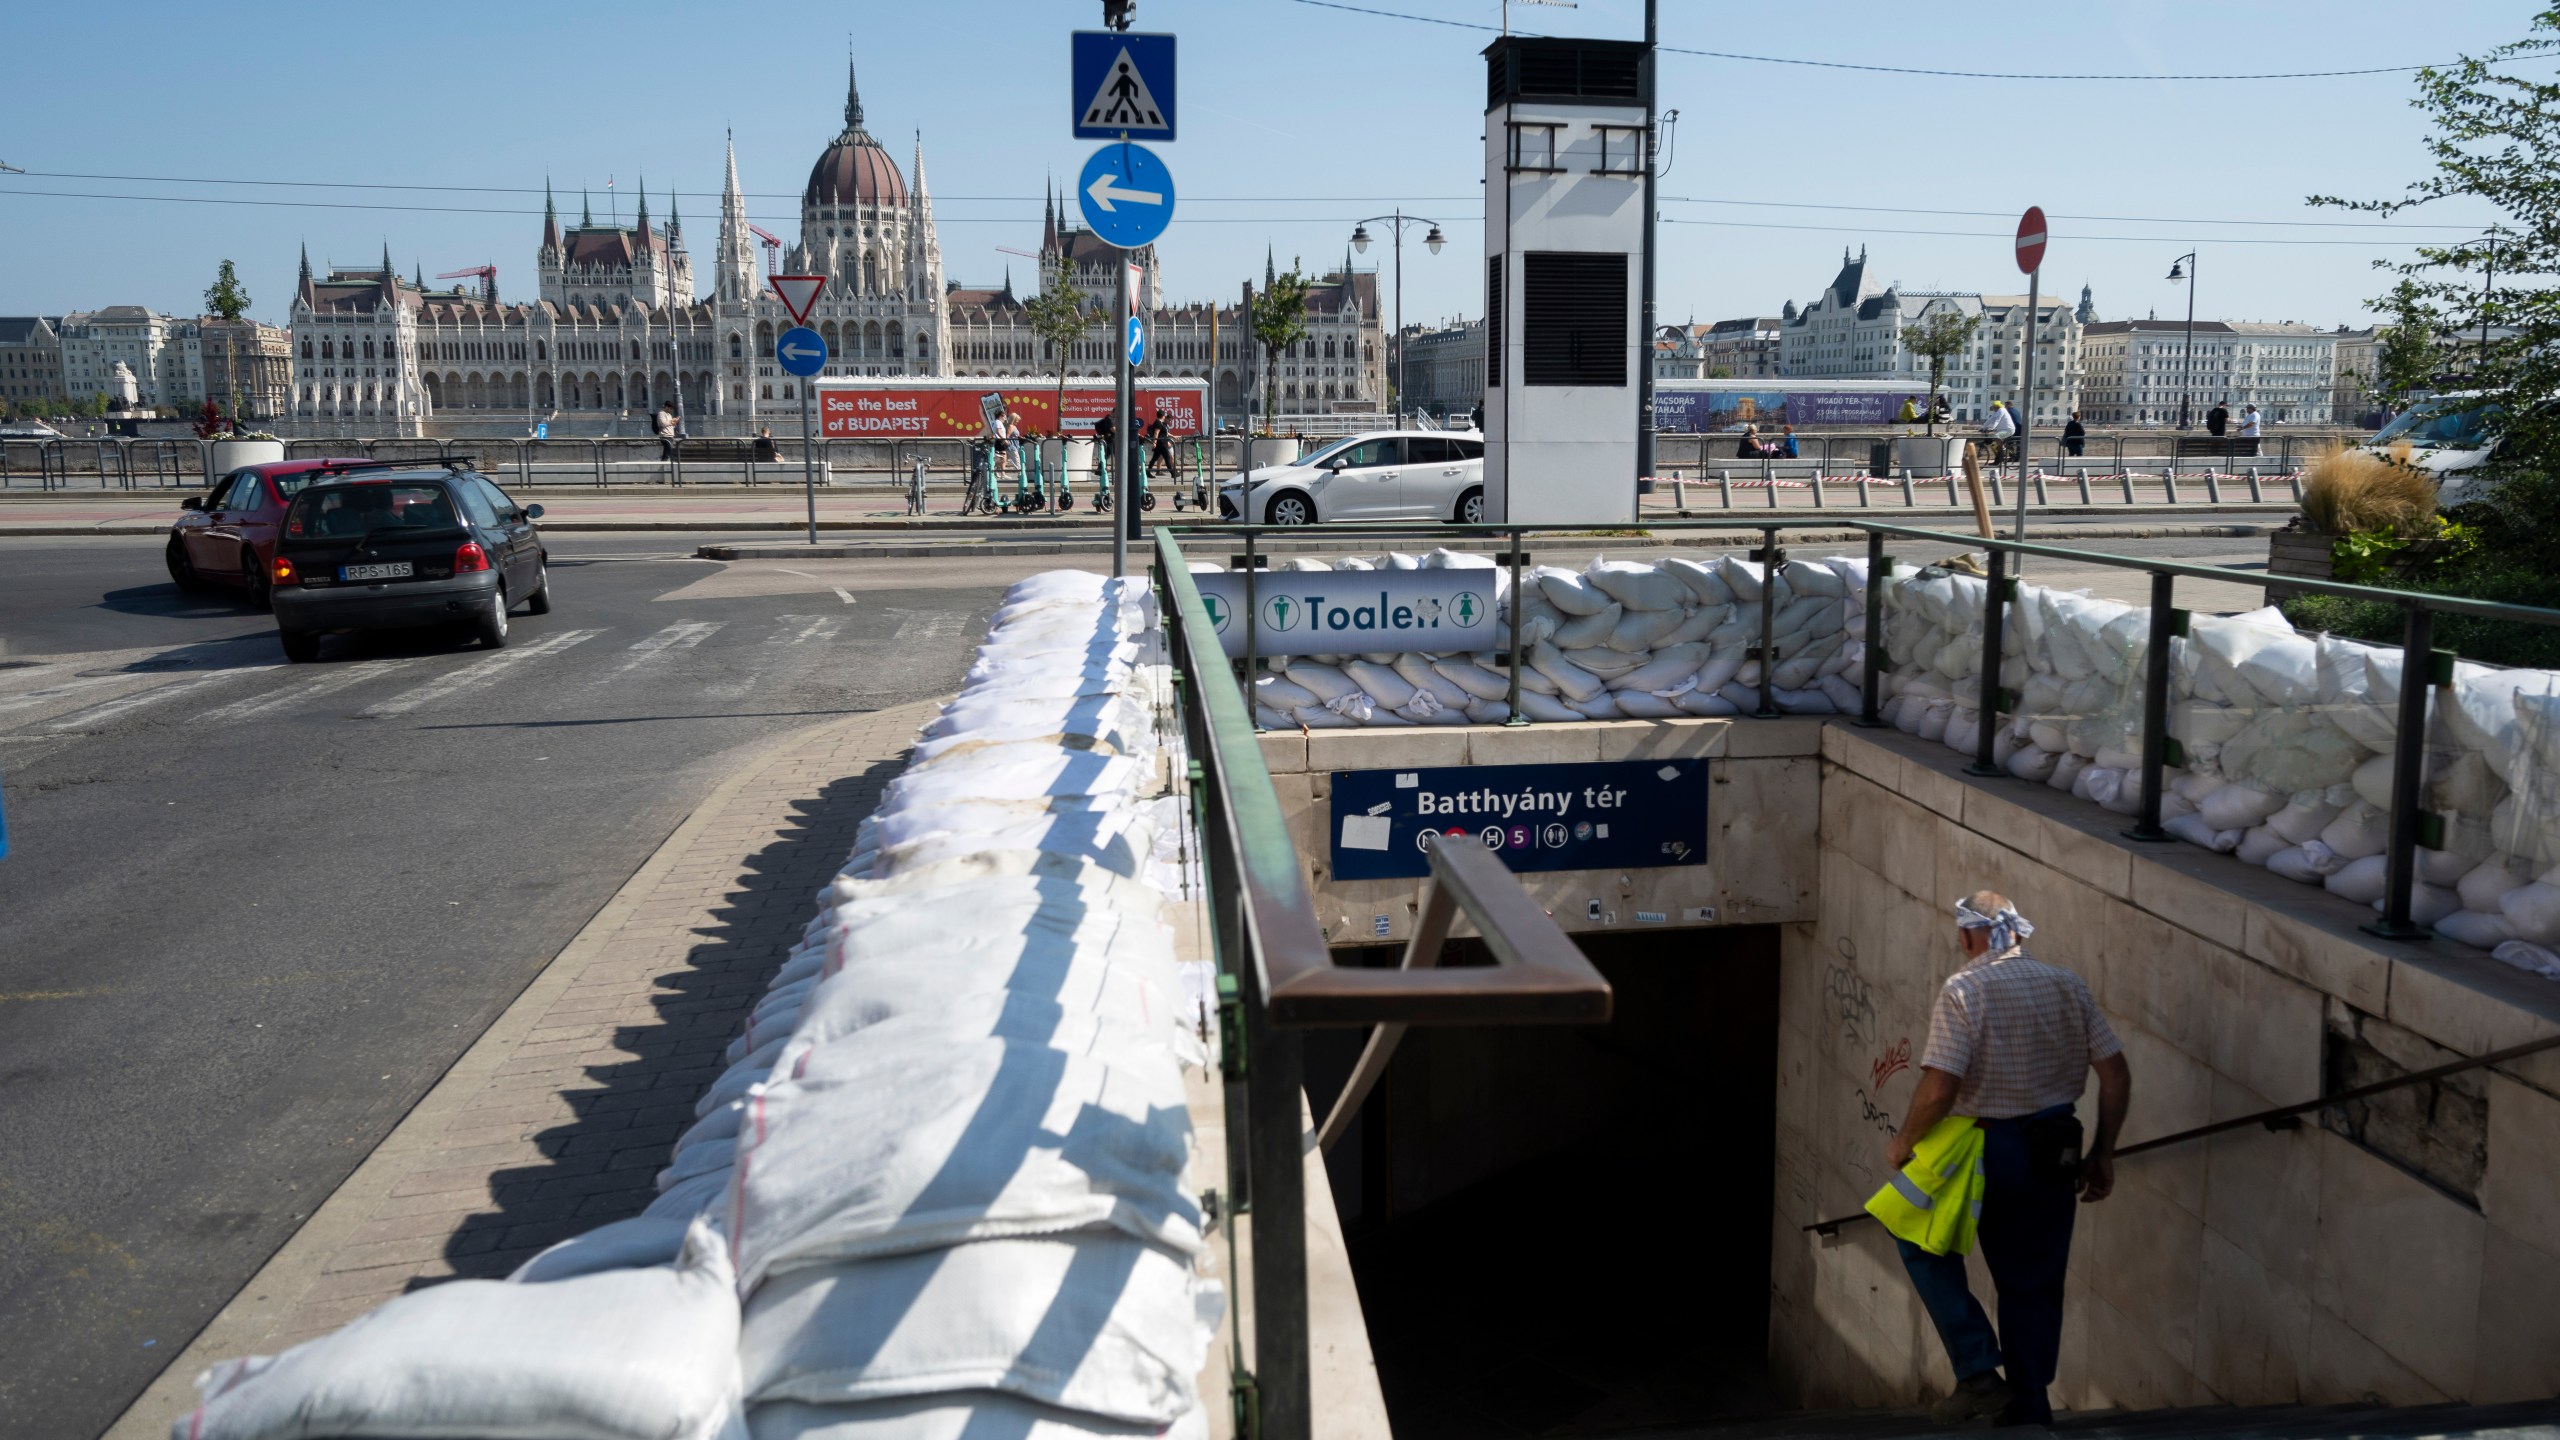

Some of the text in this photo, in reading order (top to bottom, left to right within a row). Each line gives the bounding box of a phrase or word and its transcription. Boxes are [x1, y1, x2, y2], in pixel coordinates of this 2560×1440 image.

[827, 397, 917, 411] See the best
[1155, 396, 1181, 408] GET
[827, 417, 930, 431] of BUDAPEST
[1166, 418, 1196, 430] UIDE
[348, 563, 411, 579] RPS-165
[1417, 788, 1573, 819] Batthyány
[1583, 784, 1628, 809] tér
[1513, 830, 1525, 844] 5
